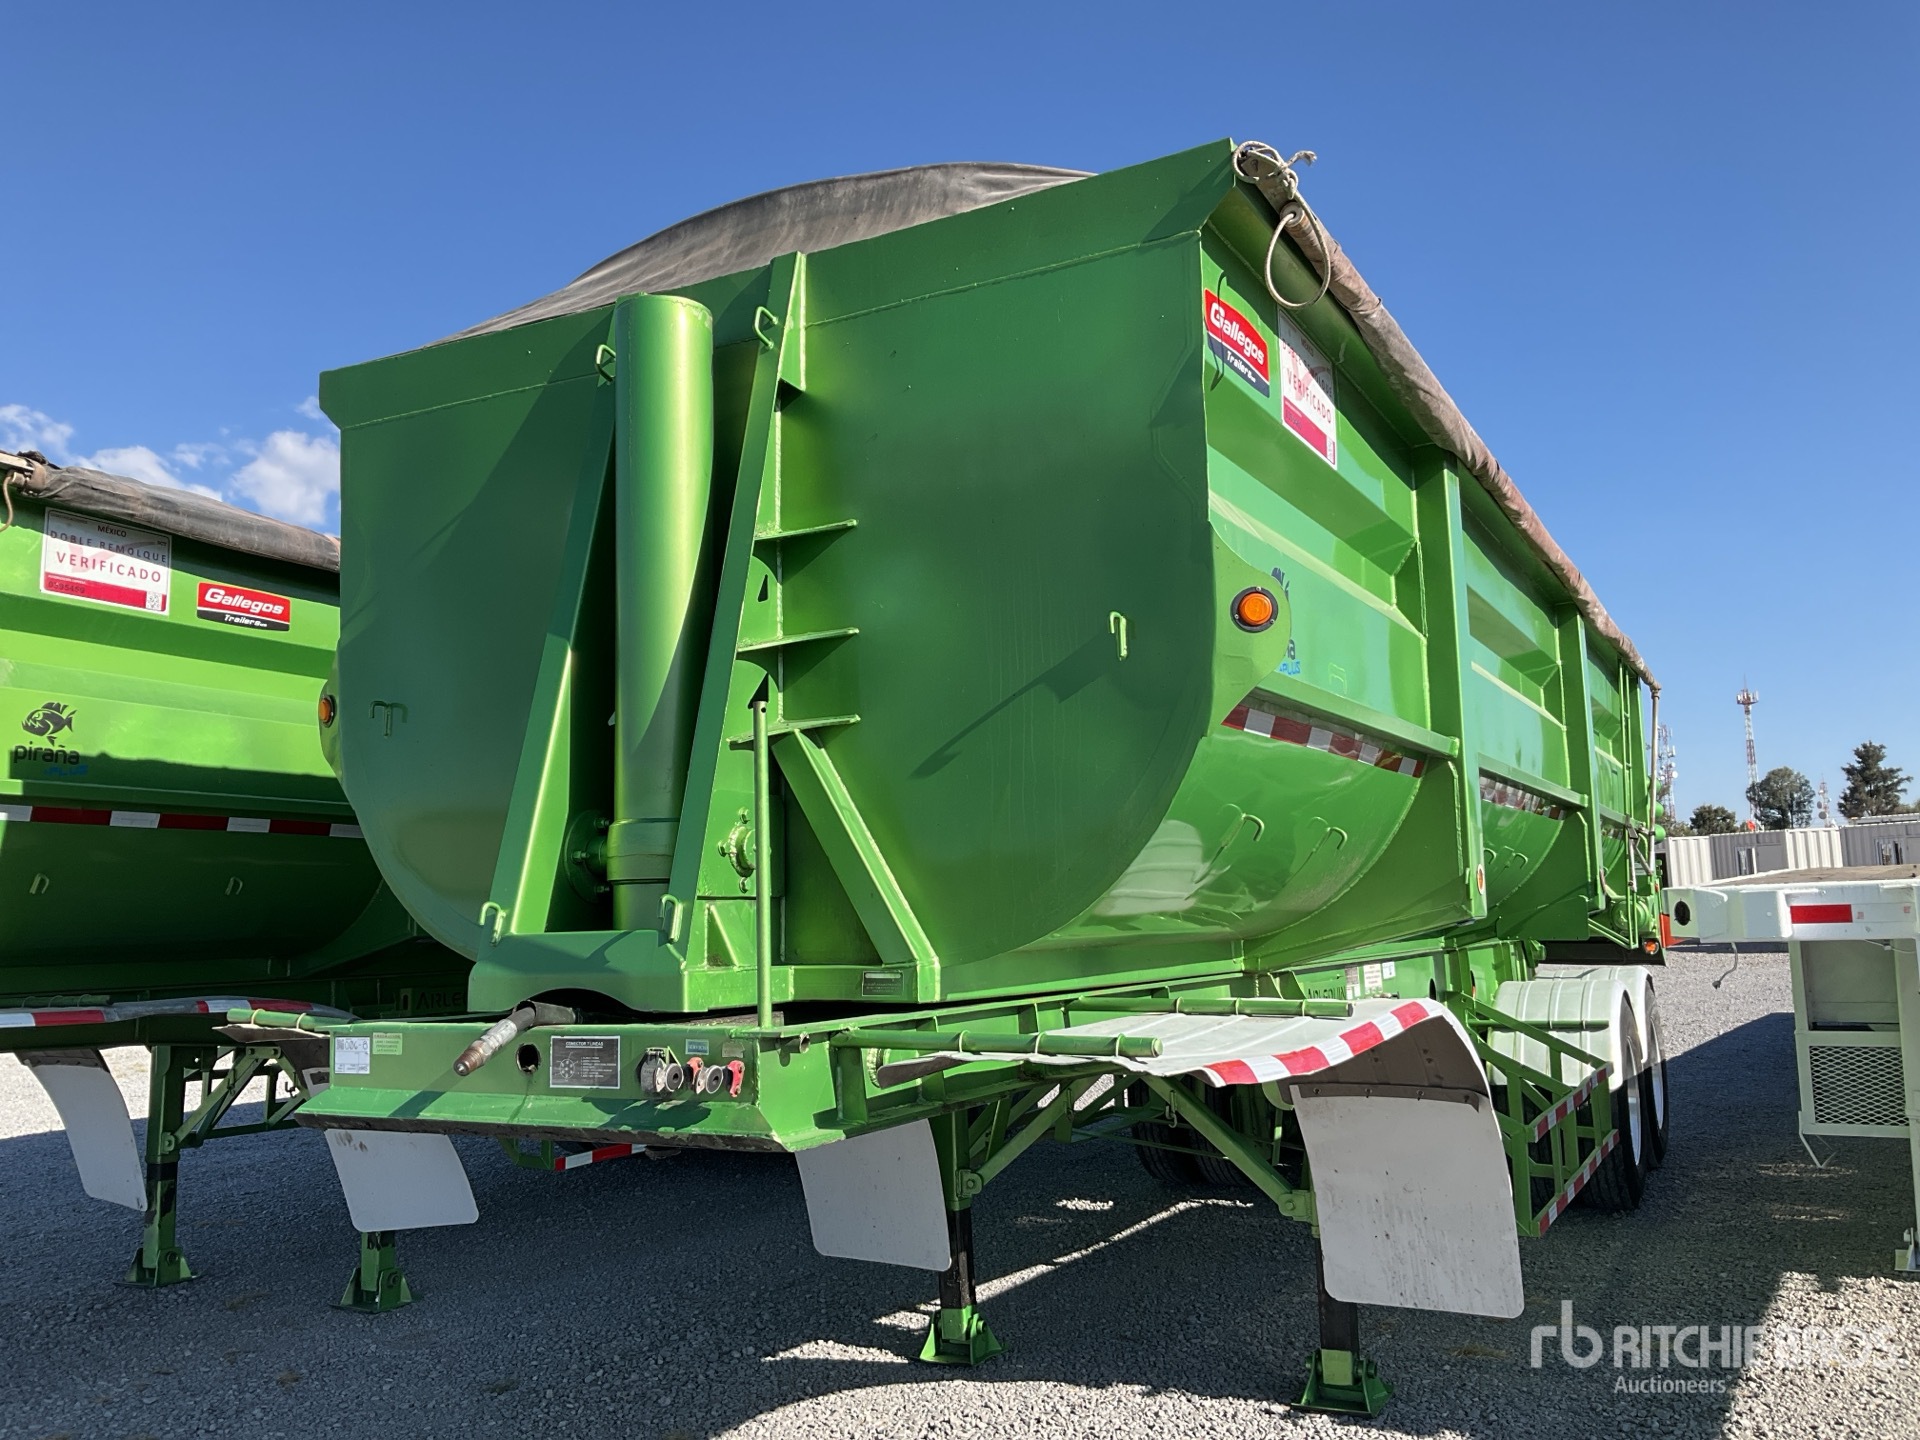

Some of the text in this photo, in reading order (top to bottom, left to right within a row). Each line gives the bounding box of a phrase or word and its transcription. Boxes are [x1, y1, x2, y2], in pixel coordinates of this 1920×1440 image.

[1210, 302, 1265, 366] Gallegos
[1226, 350, 1253, 379] Trailers
[1286, 368, 1332, 424] VERIFICADO
[97, 524, 127, 537] MÉXICO
[50, 530, 167, 563] DOBLE REMOLQUE
[56, 551, 161, 582] VERIFICADO
[204, 588, 285, 615] Gallegos
[224, 614, 261, 626] Trailers
[13, 741, 80, 765] piraña
[416, 991, 467, 1010] ARLE
